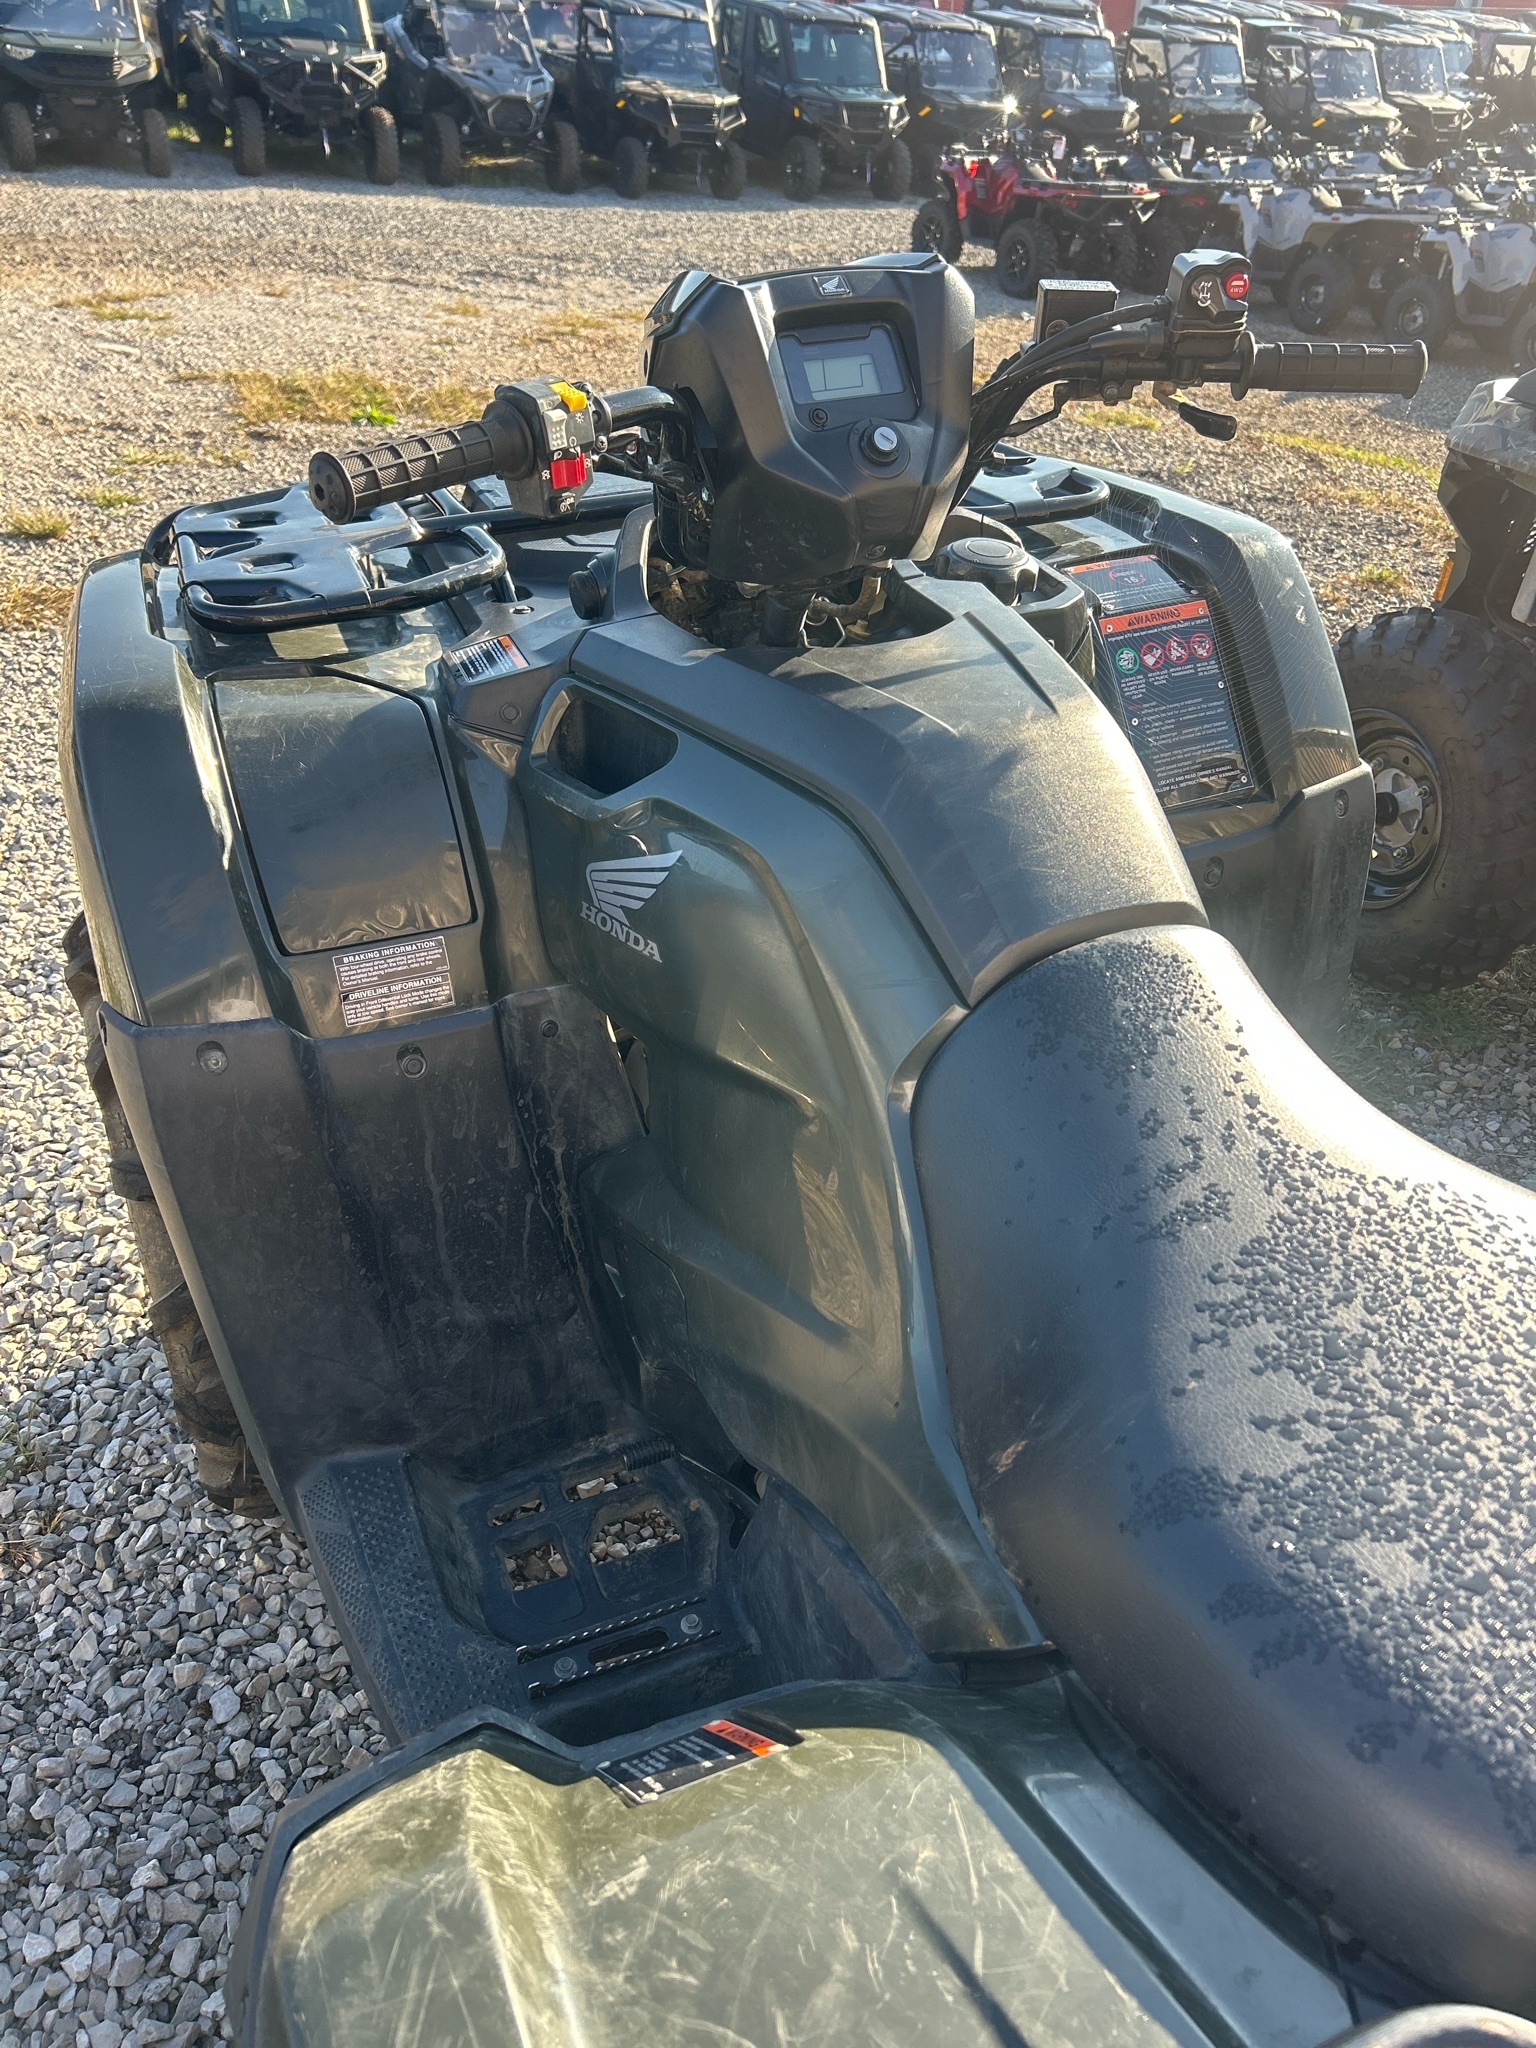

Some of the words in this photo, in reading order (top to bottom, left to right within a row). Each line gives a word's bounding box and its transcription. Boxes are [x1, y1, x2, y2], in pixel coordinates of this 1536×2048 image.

[1133, 607, 1180, 625] WARNING
[580, 900, 662, 963] HONDA
[342, 950, 379, 963] BRAKING
[381, 940, 435, 956] INFORMATION
[348, 986, 389, 999] DRIVELINE
[390, 976, 442, 991] INFORMATION
